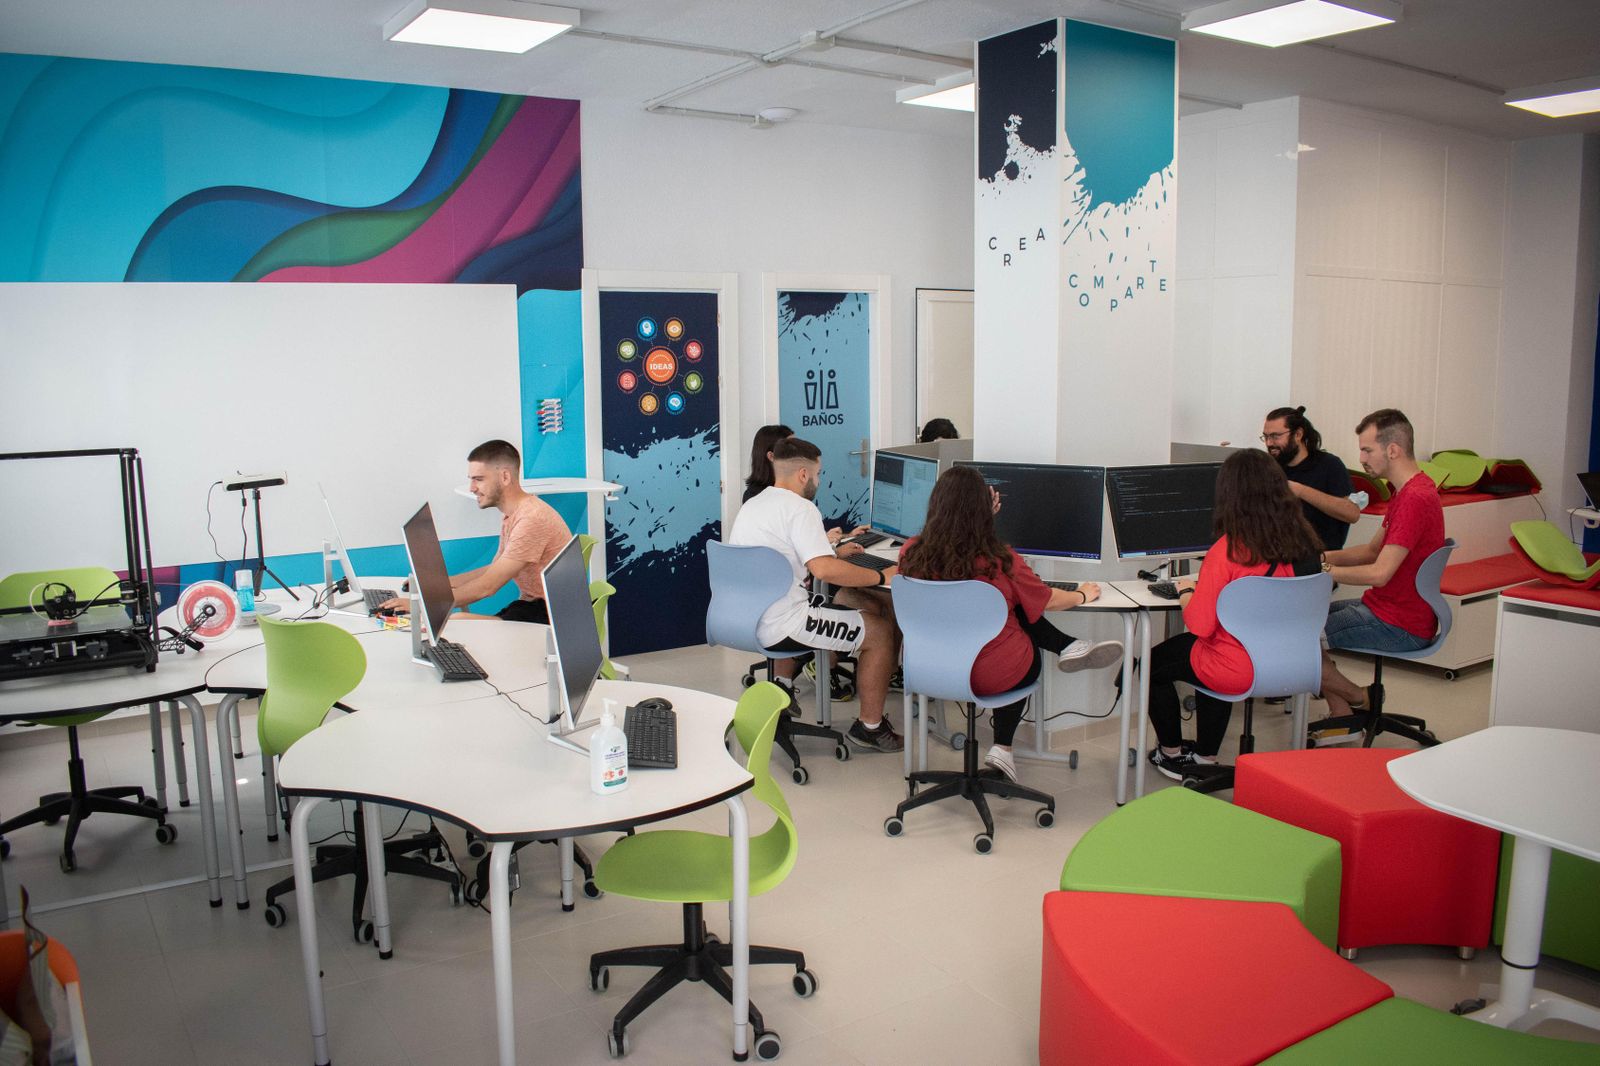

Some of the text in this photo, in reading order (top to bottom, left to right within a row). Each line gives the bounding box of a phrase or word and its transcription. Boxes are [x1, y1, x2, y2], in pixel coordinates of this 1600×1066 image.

[988, 228, 1045, 267] CREA
[1068, 260, 1167, 312] COMPARTE
[649, 363, 673, 371] IDEAS
[802, 412, 844, 427] BAÑOS
[805, 615, 861, 642] PUMA
